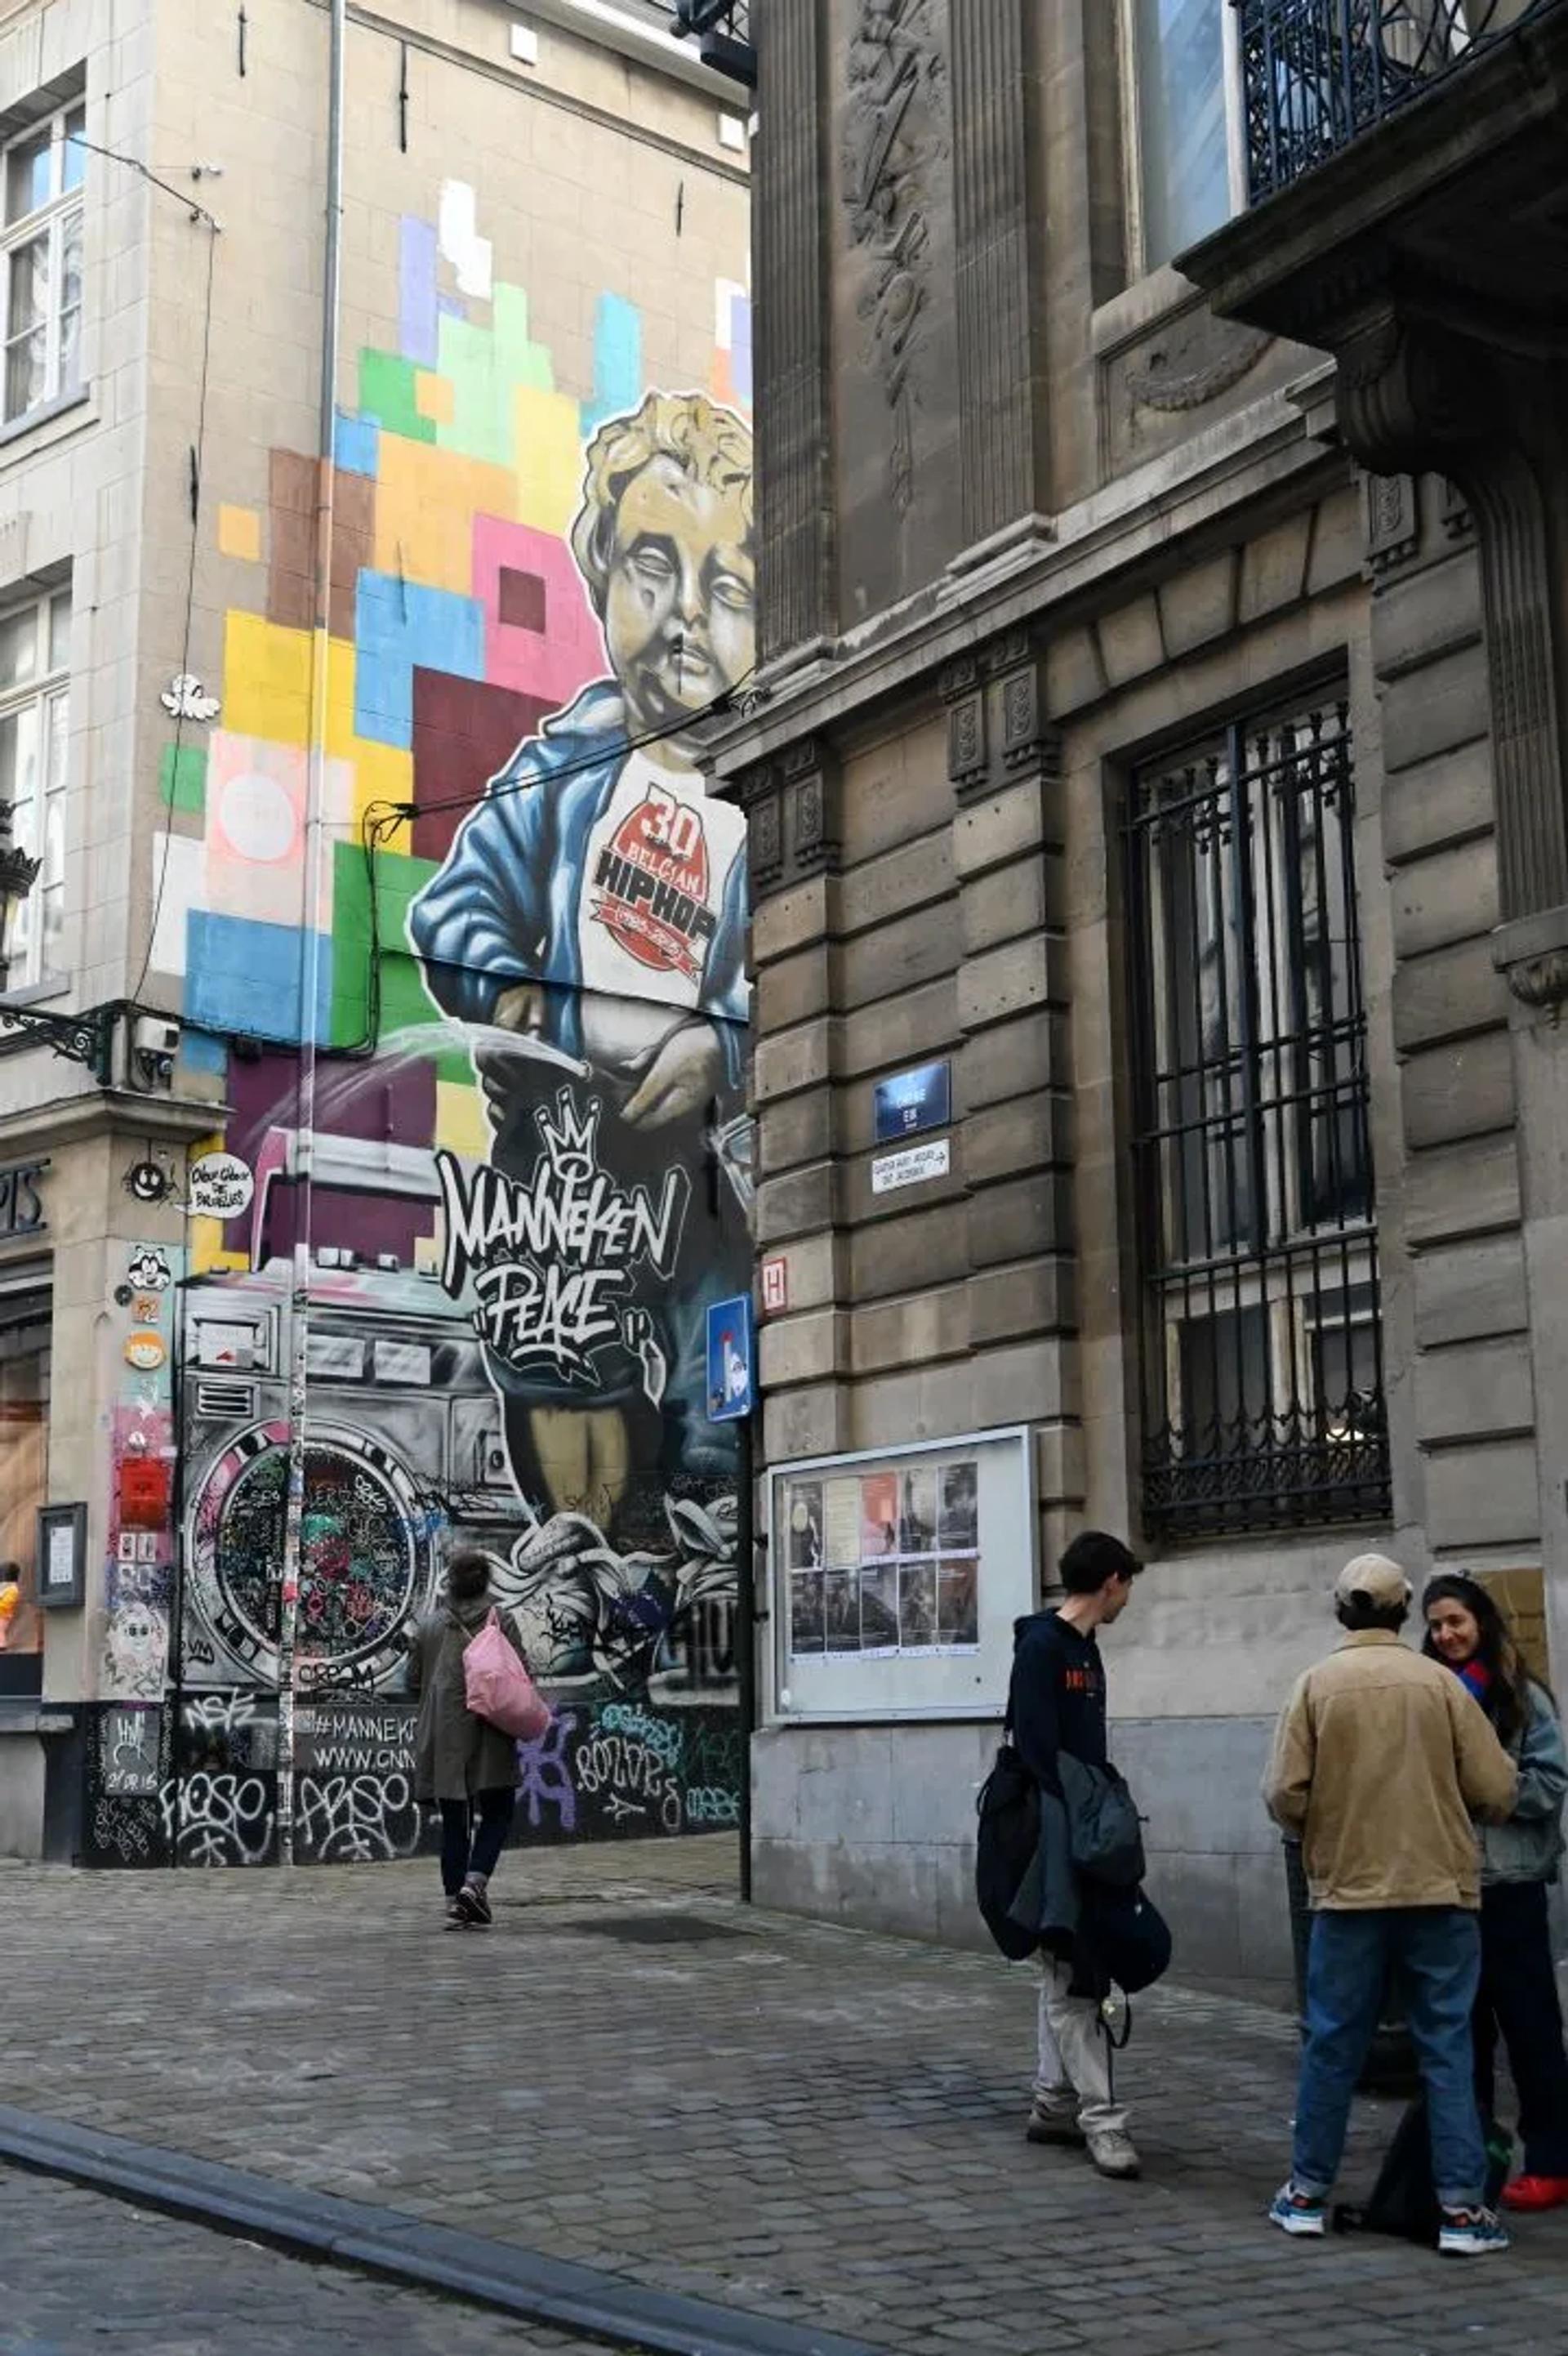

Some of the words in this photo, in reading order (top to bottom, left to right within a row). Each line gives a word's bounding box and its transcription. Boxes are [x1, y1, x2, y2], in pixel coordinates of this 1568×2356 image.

[641, 782, 703, 859] 30
[594, 849, 717, 941] HIPHOP
[627, 841, 701, 895] BELGIAN
[436, 1152, 679, 1291] MANNEKEN
[767, 1269, 780, 1302] H
